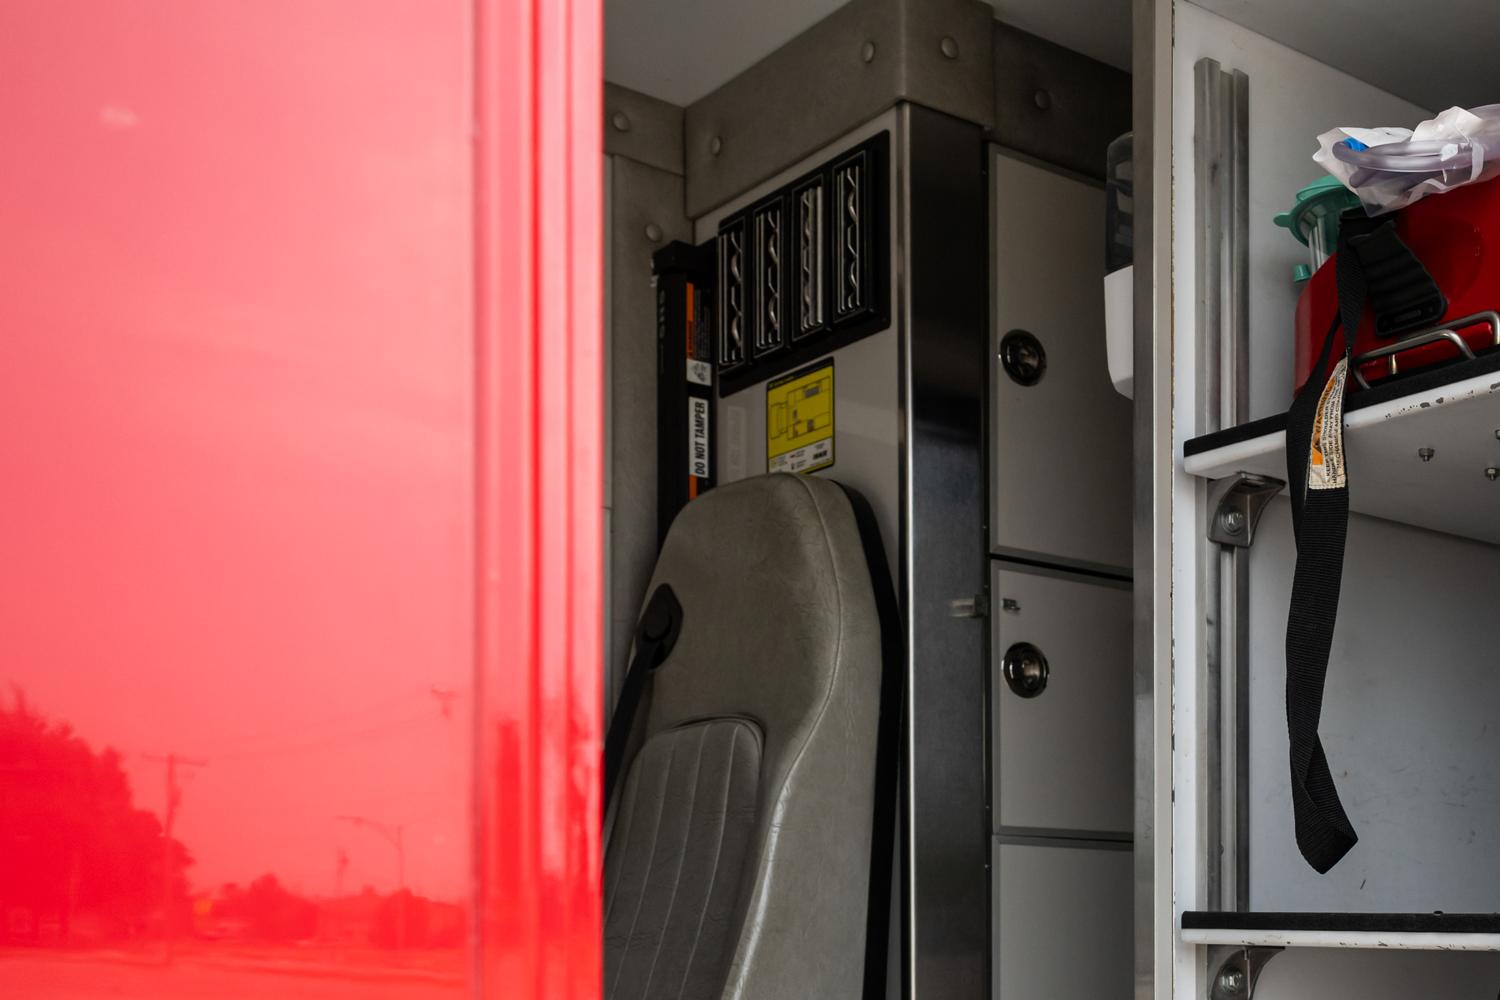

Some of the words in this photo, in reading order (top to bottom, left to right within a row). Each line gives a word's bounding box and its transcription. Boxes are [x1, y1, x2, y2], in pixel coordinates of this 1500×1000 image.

[694, 401, 706, 439] TAMPER
[694, 441, 706, 460] NOT
[694, 461, 706, 476] DO
